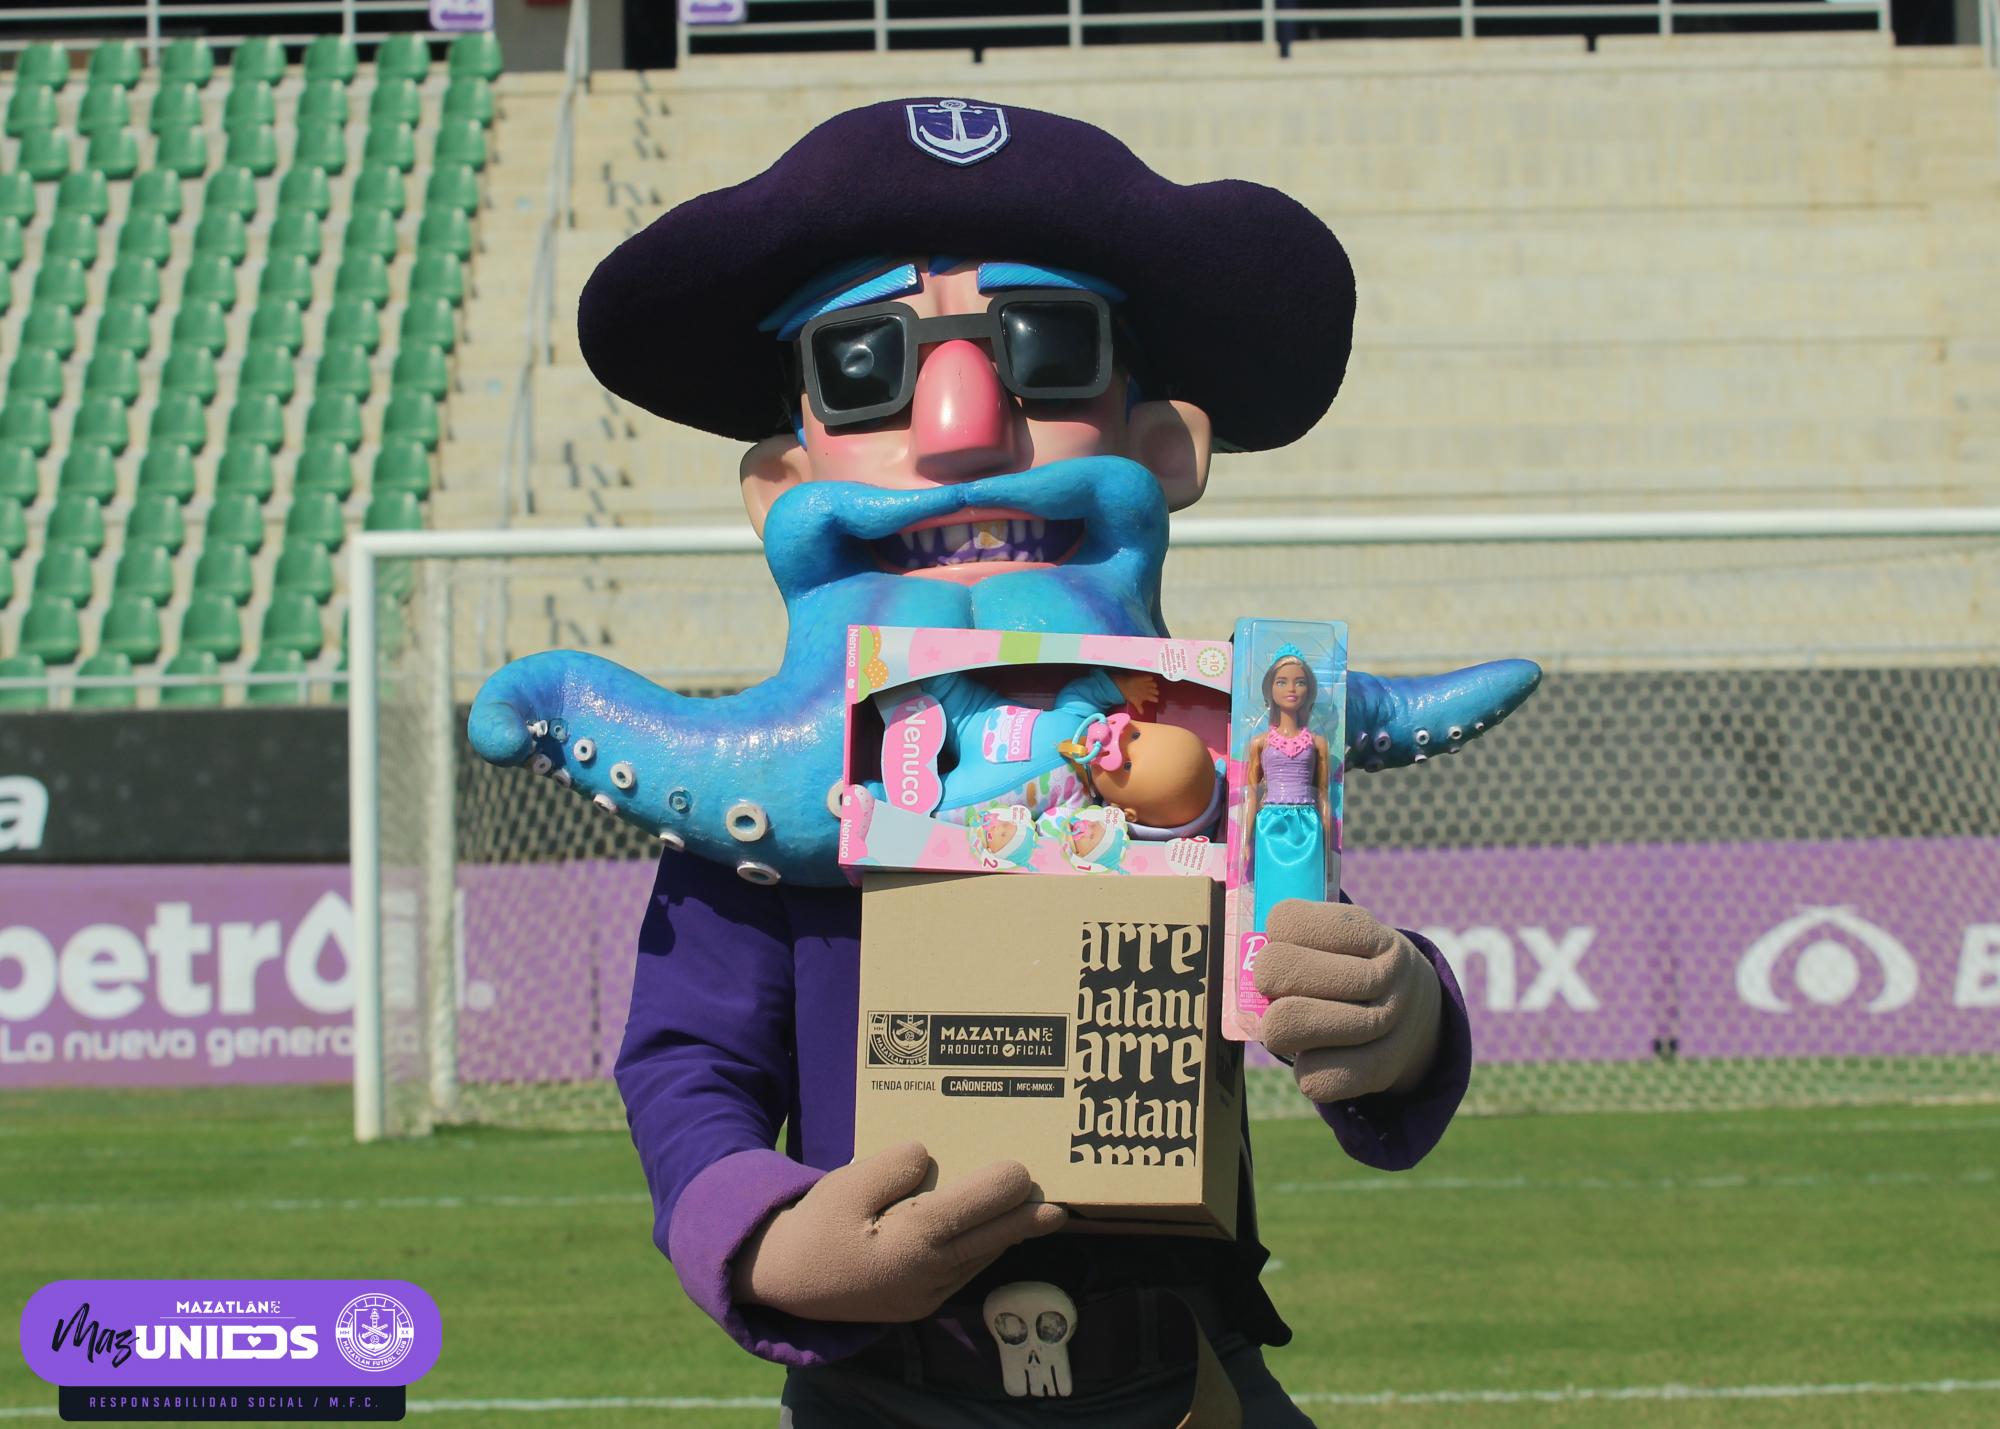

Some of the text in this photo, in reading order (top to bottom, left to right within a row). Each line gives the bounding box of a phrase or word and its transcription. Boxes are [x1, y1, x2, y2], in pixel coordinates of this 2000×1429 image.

[848, 628, 859, 668] Nenuco
[1010, 710, 1031, 756] Nenuco
[901, 700, 927, 806] Nenuco
[841, 819, 852, 858] Nenuco
[983, 857, 998, 869] 2
[1080, 922, 1202, 974] arre
[1, 1025, 54, 1063] La
[64, 1026, 196, 1062] nueva
[940, 1044, 999, 1056] PRODUCTO
[1075, 1031, 1204, 1085] arre
[871, 1080, 902, 1091] TIENDA
[904, 1081, 936, 1091] OFICIAL
[950, 1079, 1004, 1092] CAÑONEROS
